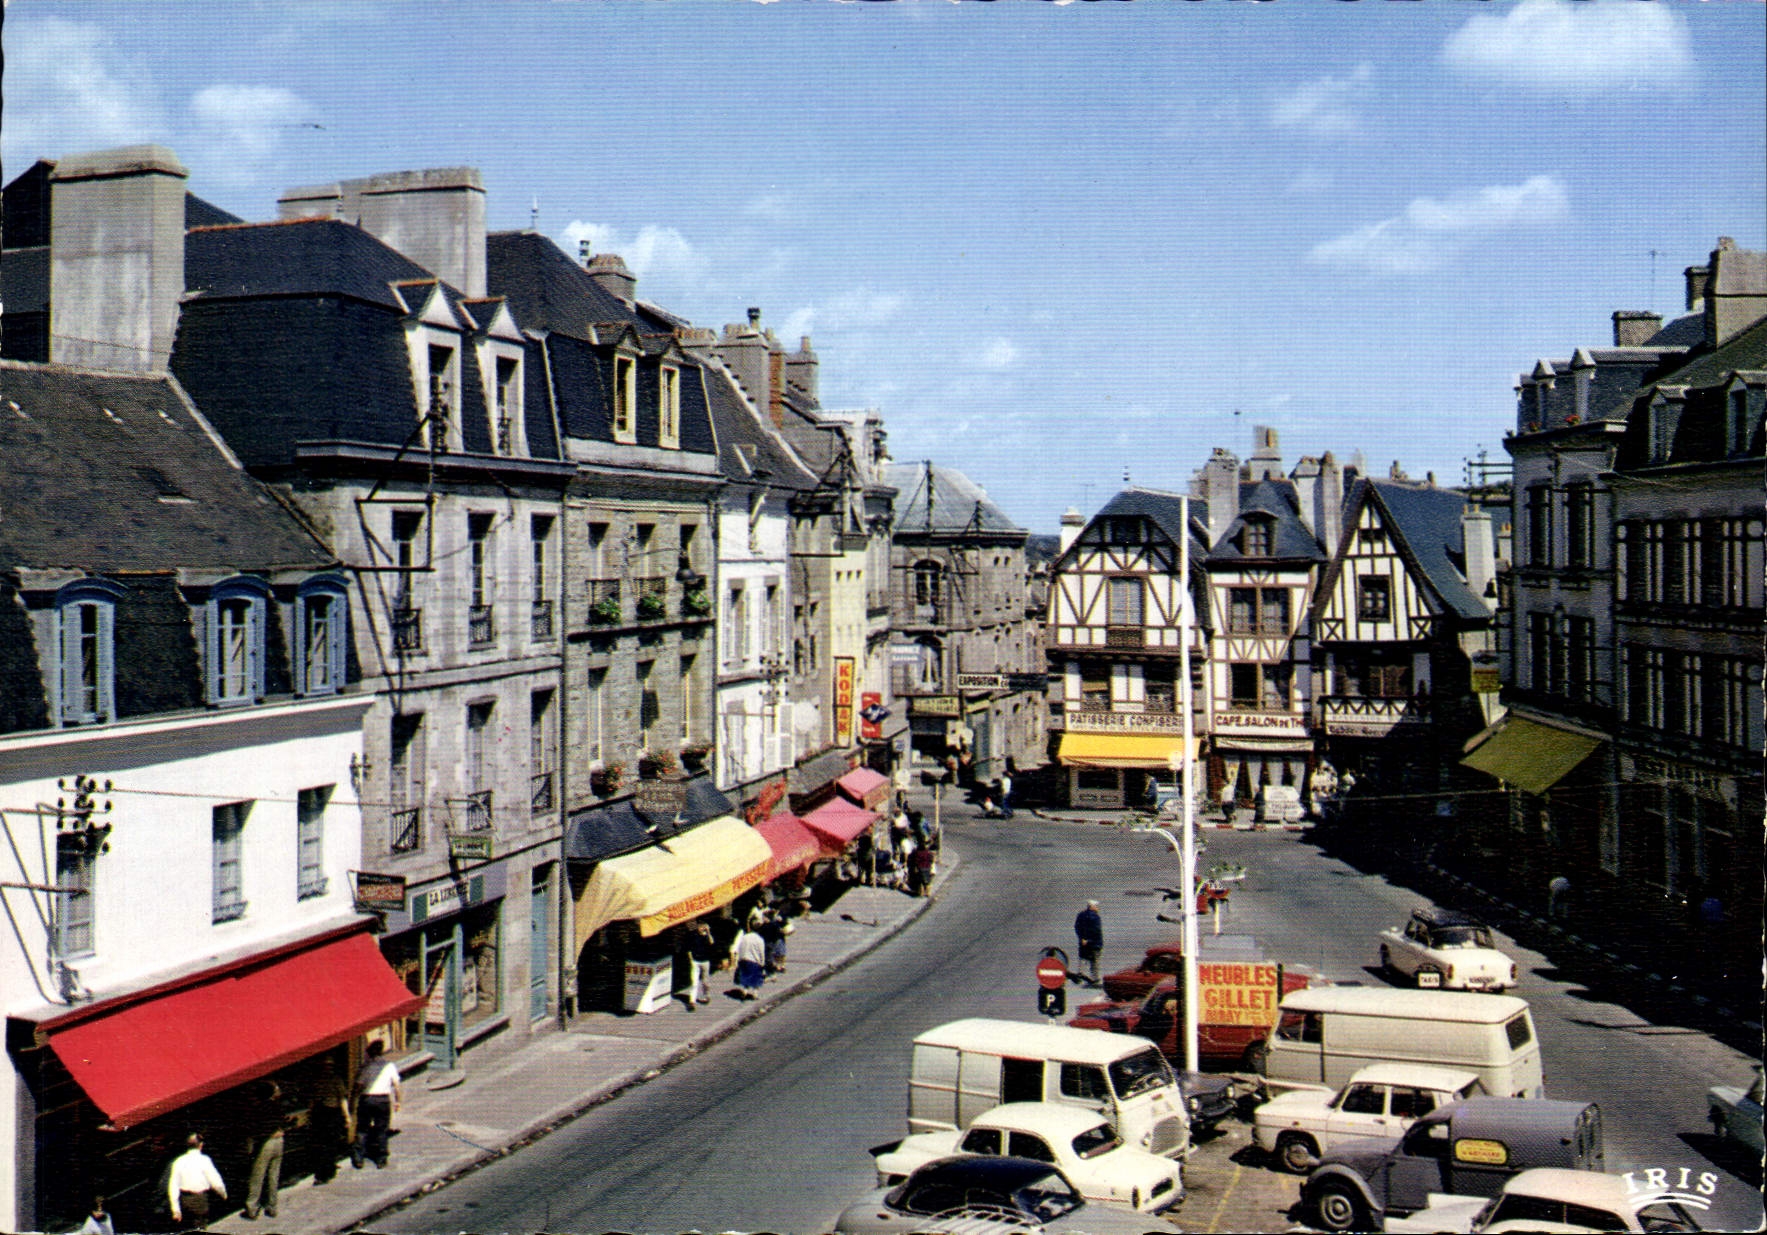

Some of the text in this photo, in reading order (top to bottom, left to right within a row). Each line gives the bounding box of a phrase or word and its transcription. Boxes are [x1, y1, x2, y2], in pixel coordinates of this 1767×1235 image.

[958, 675, 1000, 688] EXPOSITION
[838, 663, 851, 732] KODAK
[1070, 713, 1125, 726] PATISSERIE
[1199, 963, 1277, 987] MEUBLES
[1046, 993, 1056, 1008] P
[1204, 987, 1274, 1010] GILLET
